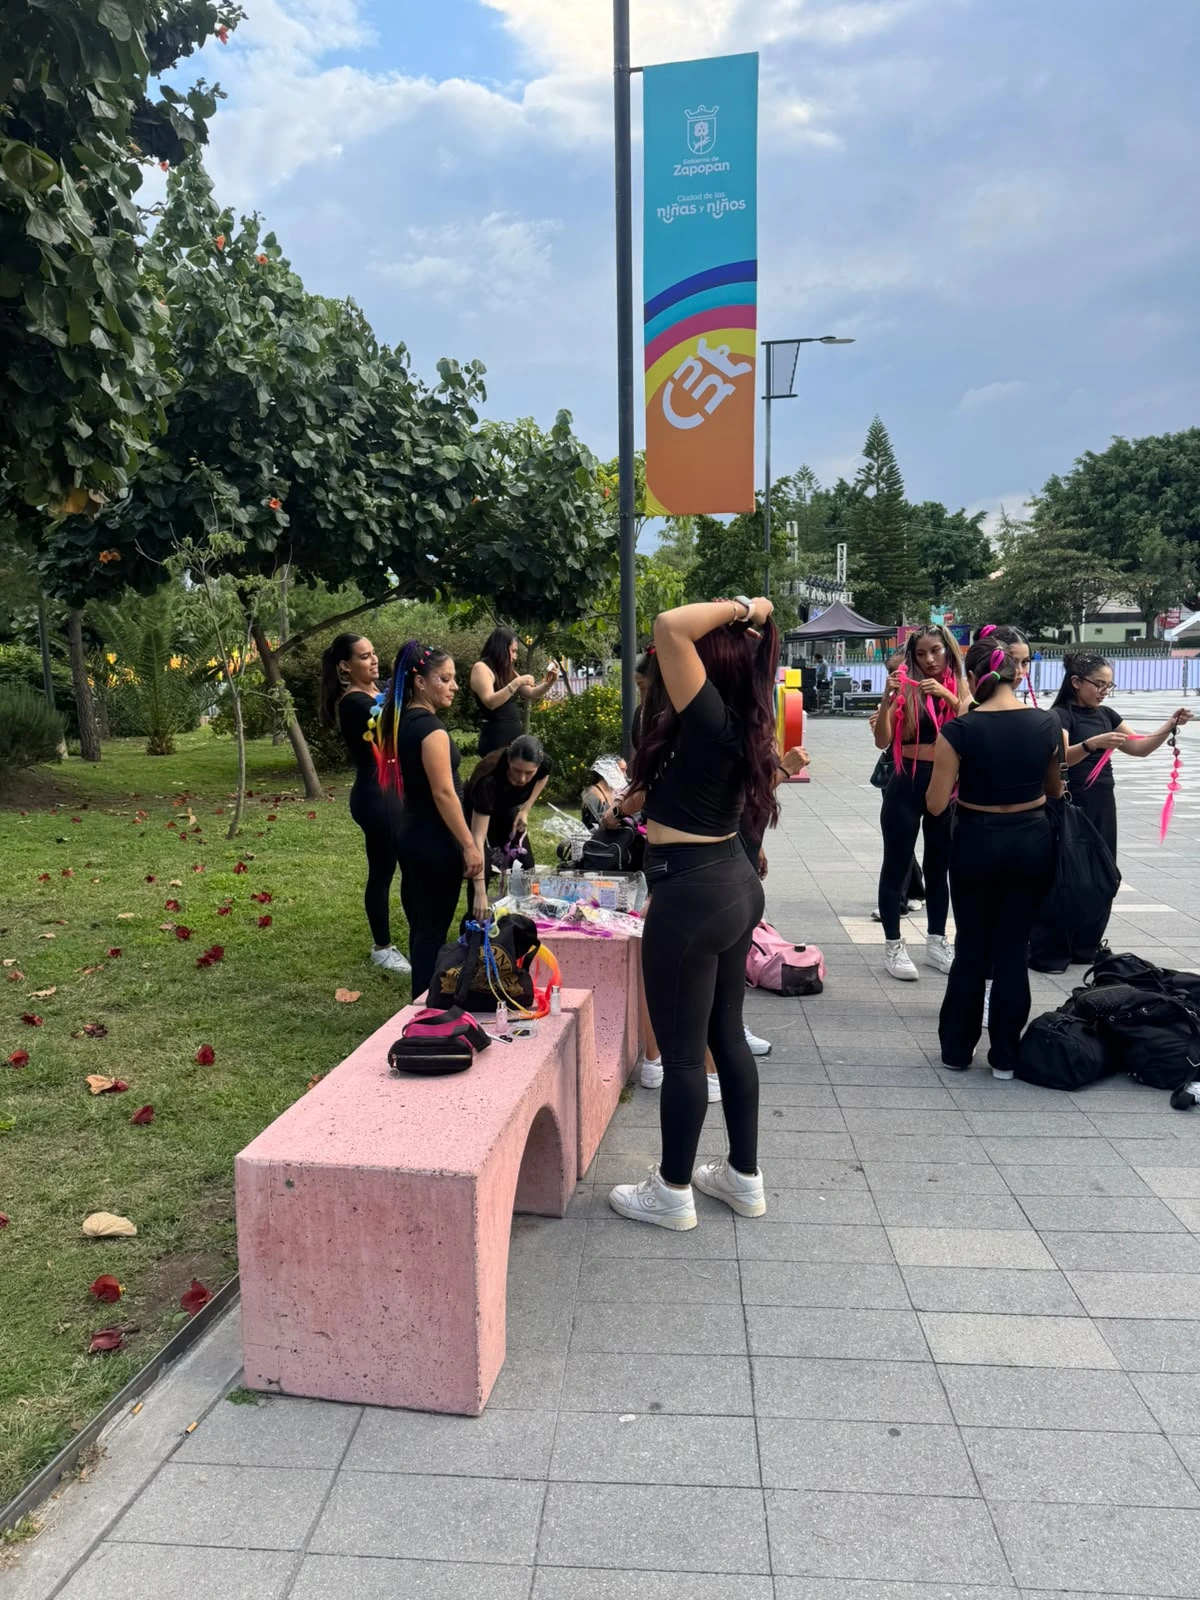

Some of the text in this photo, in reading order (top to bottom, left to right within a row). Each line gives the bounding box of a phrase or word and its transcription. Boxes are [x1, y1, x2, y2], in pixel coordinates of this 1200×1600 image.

[673, 162, 729, 176] Zapopan
[677, 193, 702, 202] Ciudad
[699, 205, 705, 213] y
